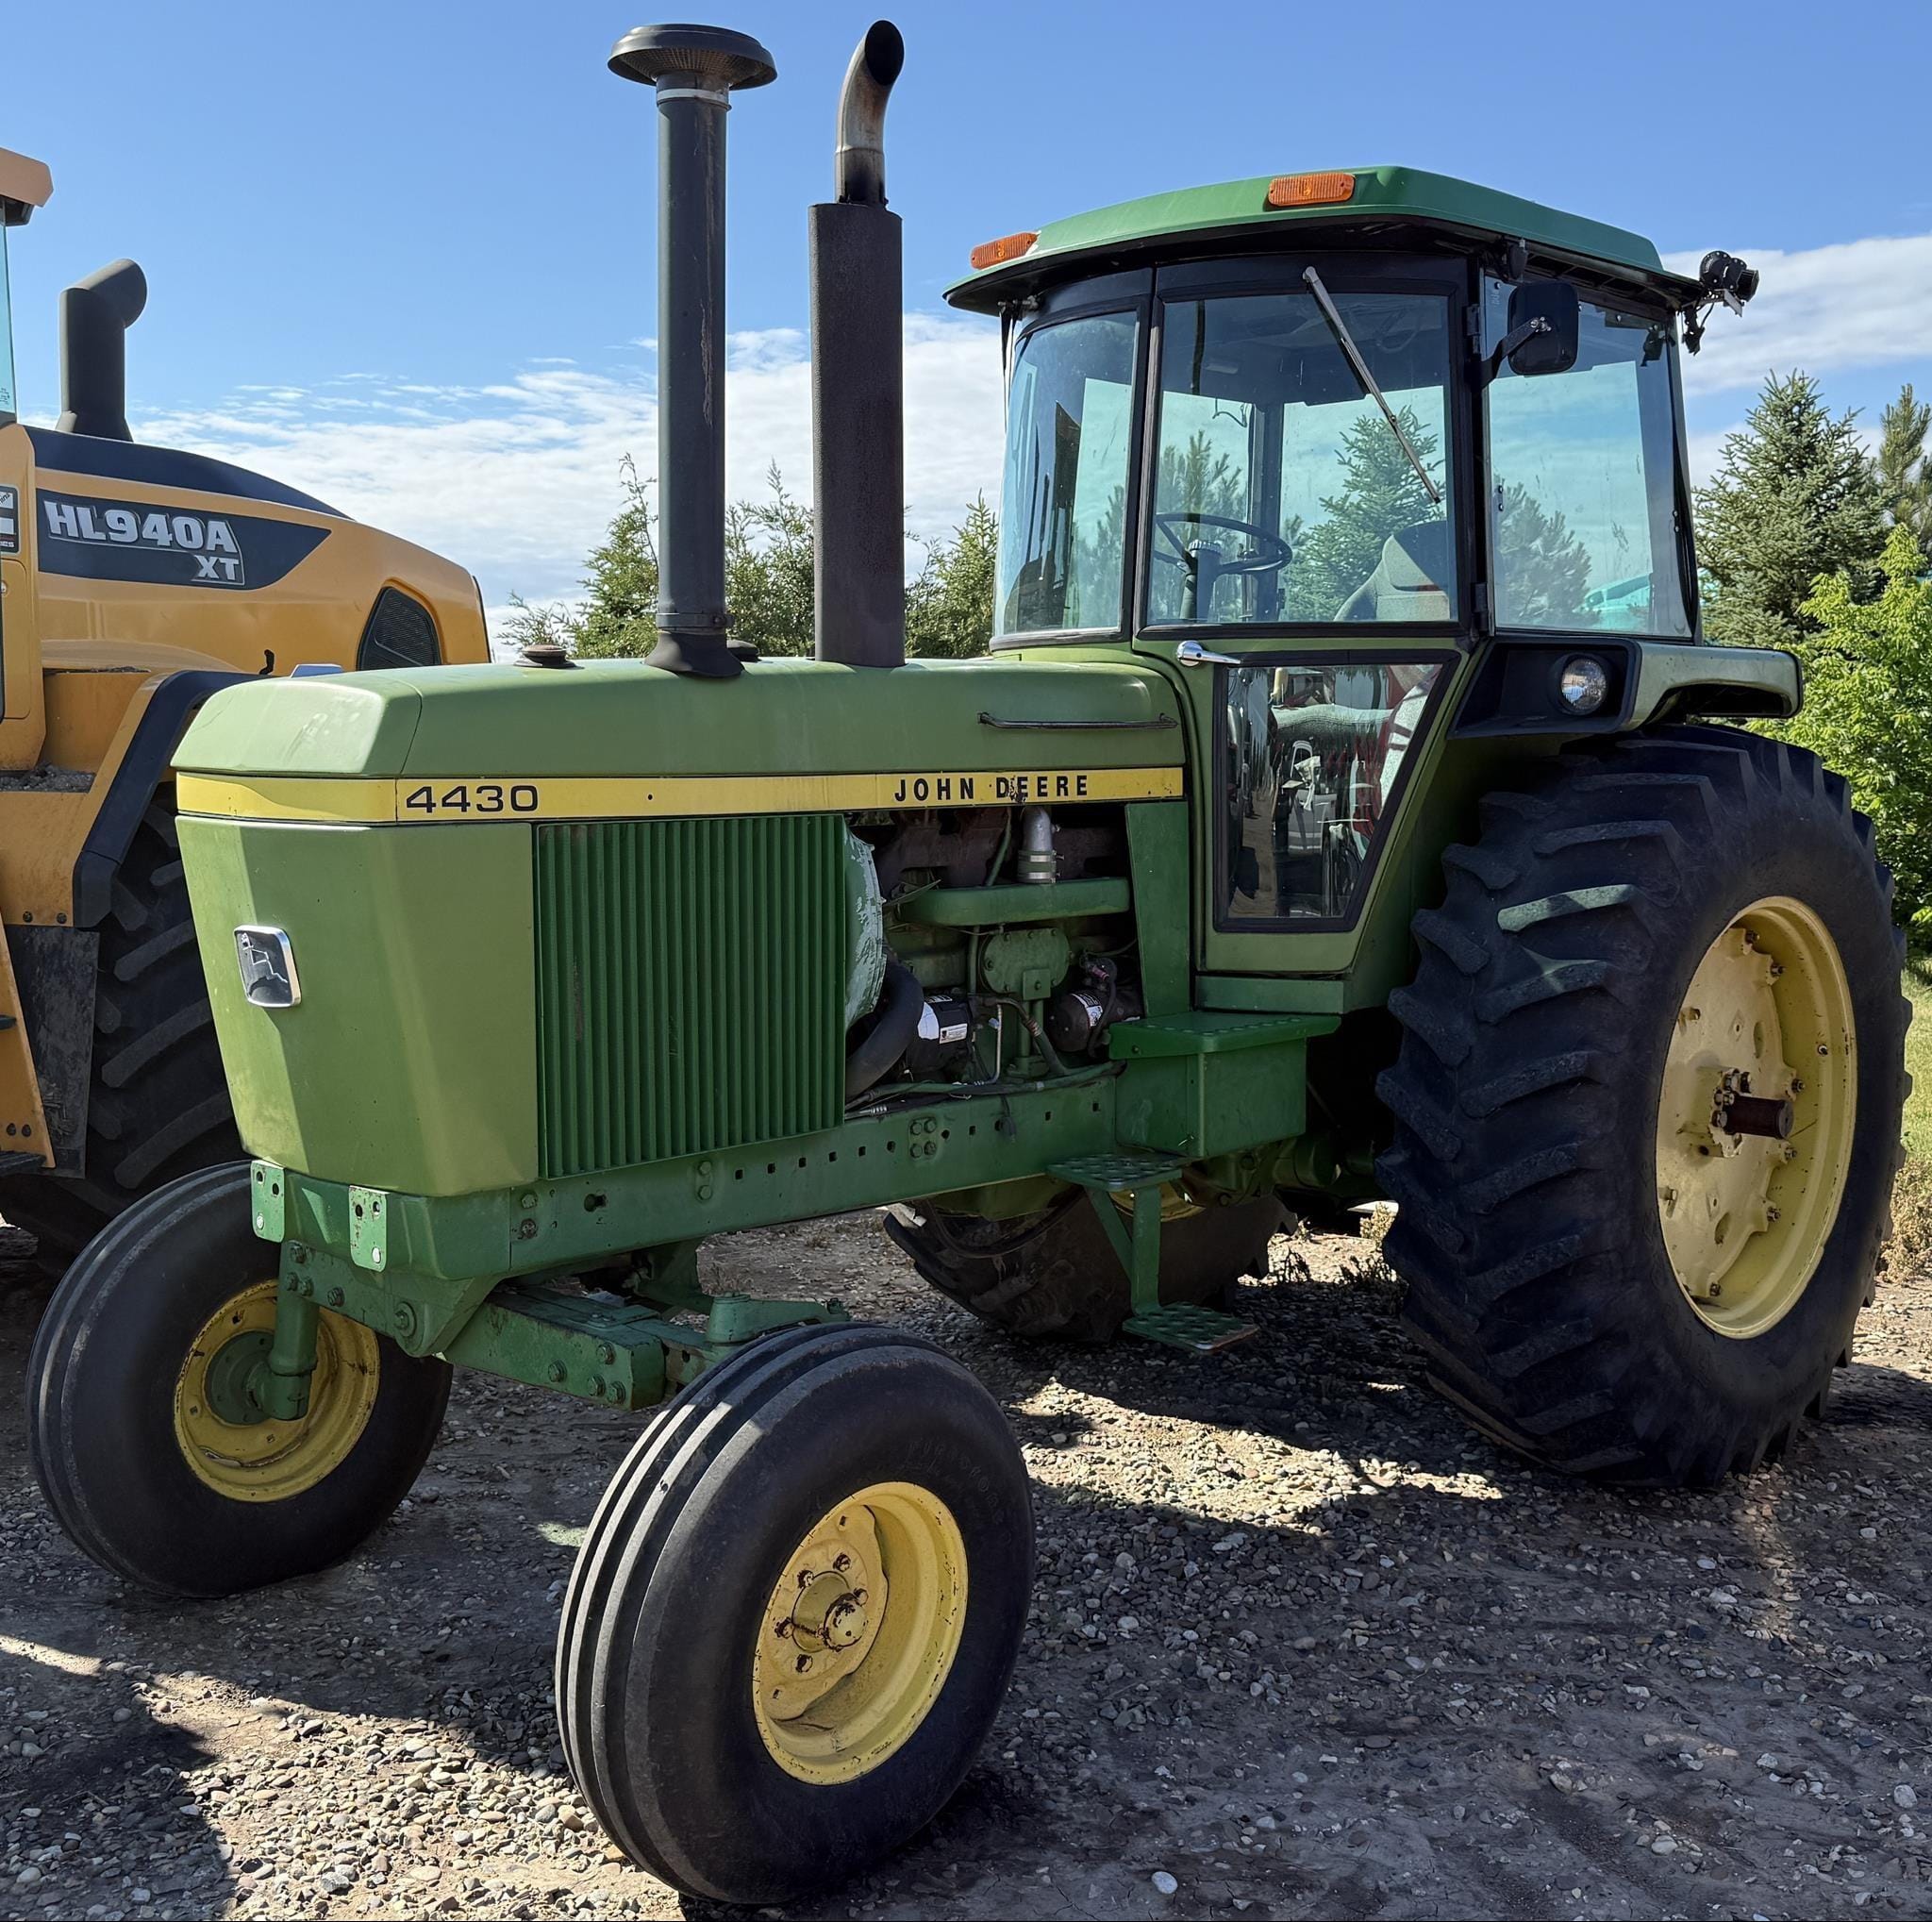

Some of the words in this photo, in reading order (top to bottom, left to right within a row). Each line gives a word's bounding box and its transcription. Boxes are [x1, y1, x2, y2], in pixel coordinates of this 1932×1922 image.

[43, 500, 239, 554] HL940A
[193, 554, 240, 580] XT
[406, 785, 539, 813] 4430
[894, 777, 974, 802] JOHN
[996, 775, 1088, 798] DEERE
